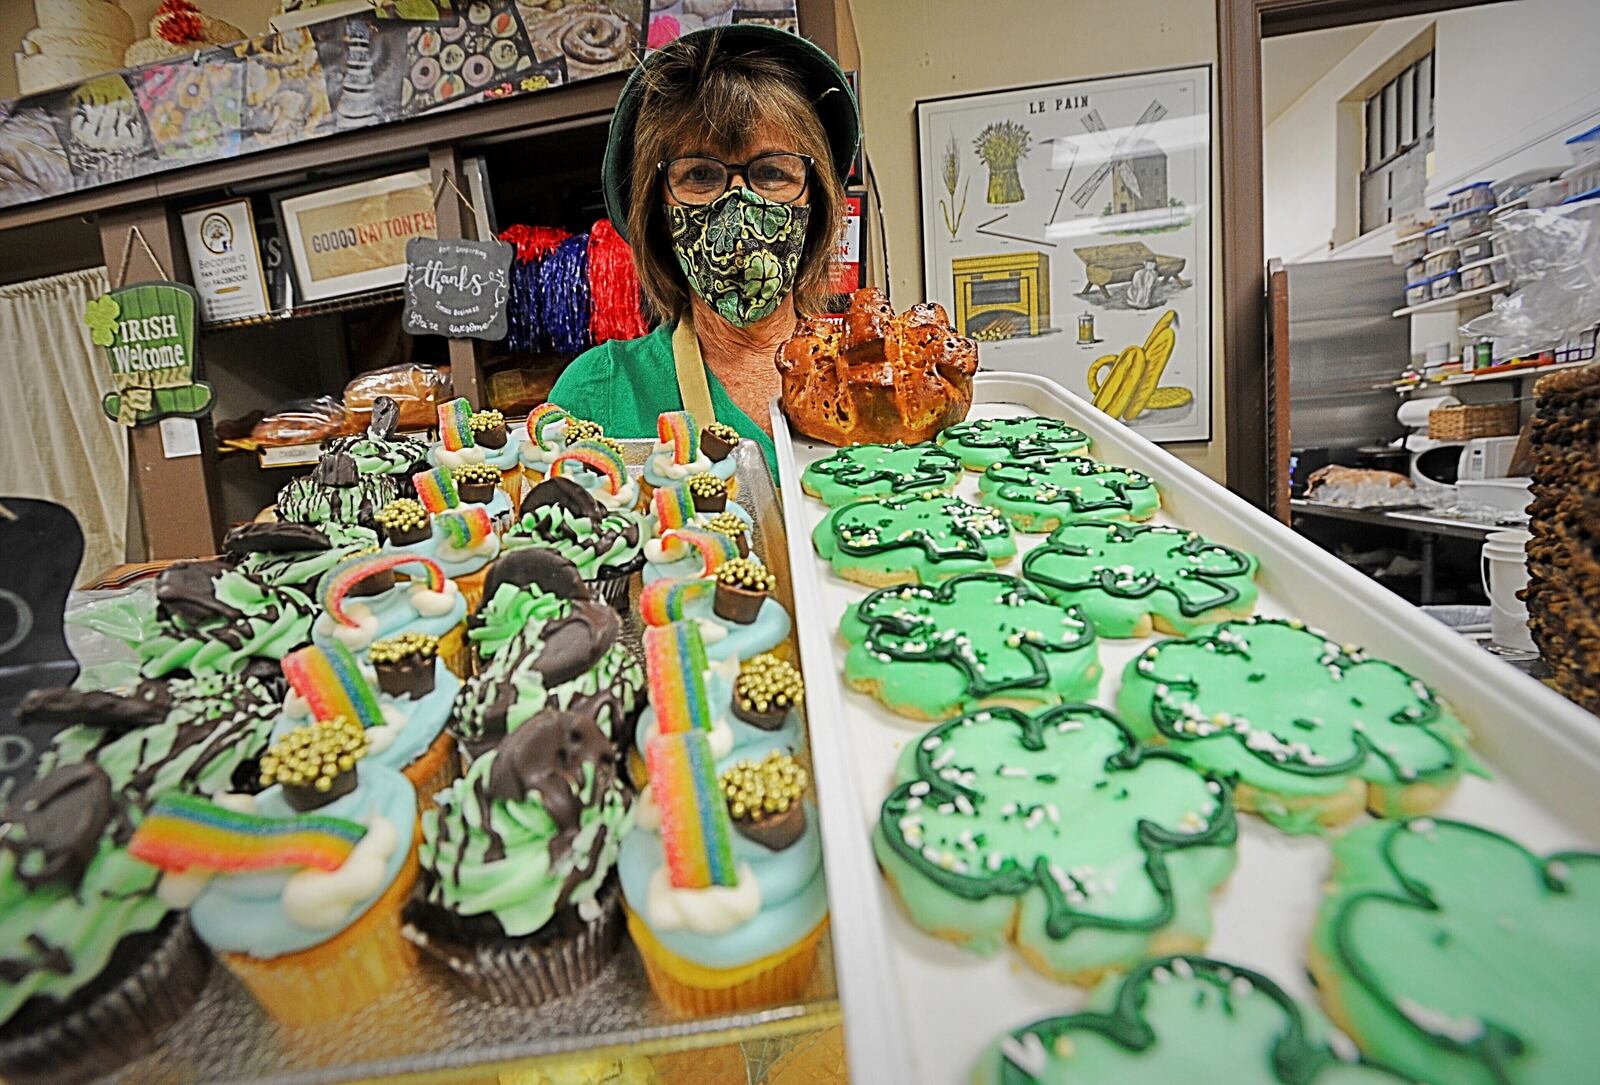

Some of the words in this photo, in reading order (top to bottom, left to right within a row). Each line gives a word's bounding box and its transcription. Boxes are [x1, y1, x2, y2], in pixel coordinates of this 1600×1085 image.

[1029, 101, 1046, 114] LE
[1055, 95, 1089, 111] PAIN
[420, 259, 484, 296] thanks
[119, 314, 179, 343] IRISH
[112, 343, 186, 374] Welcome
